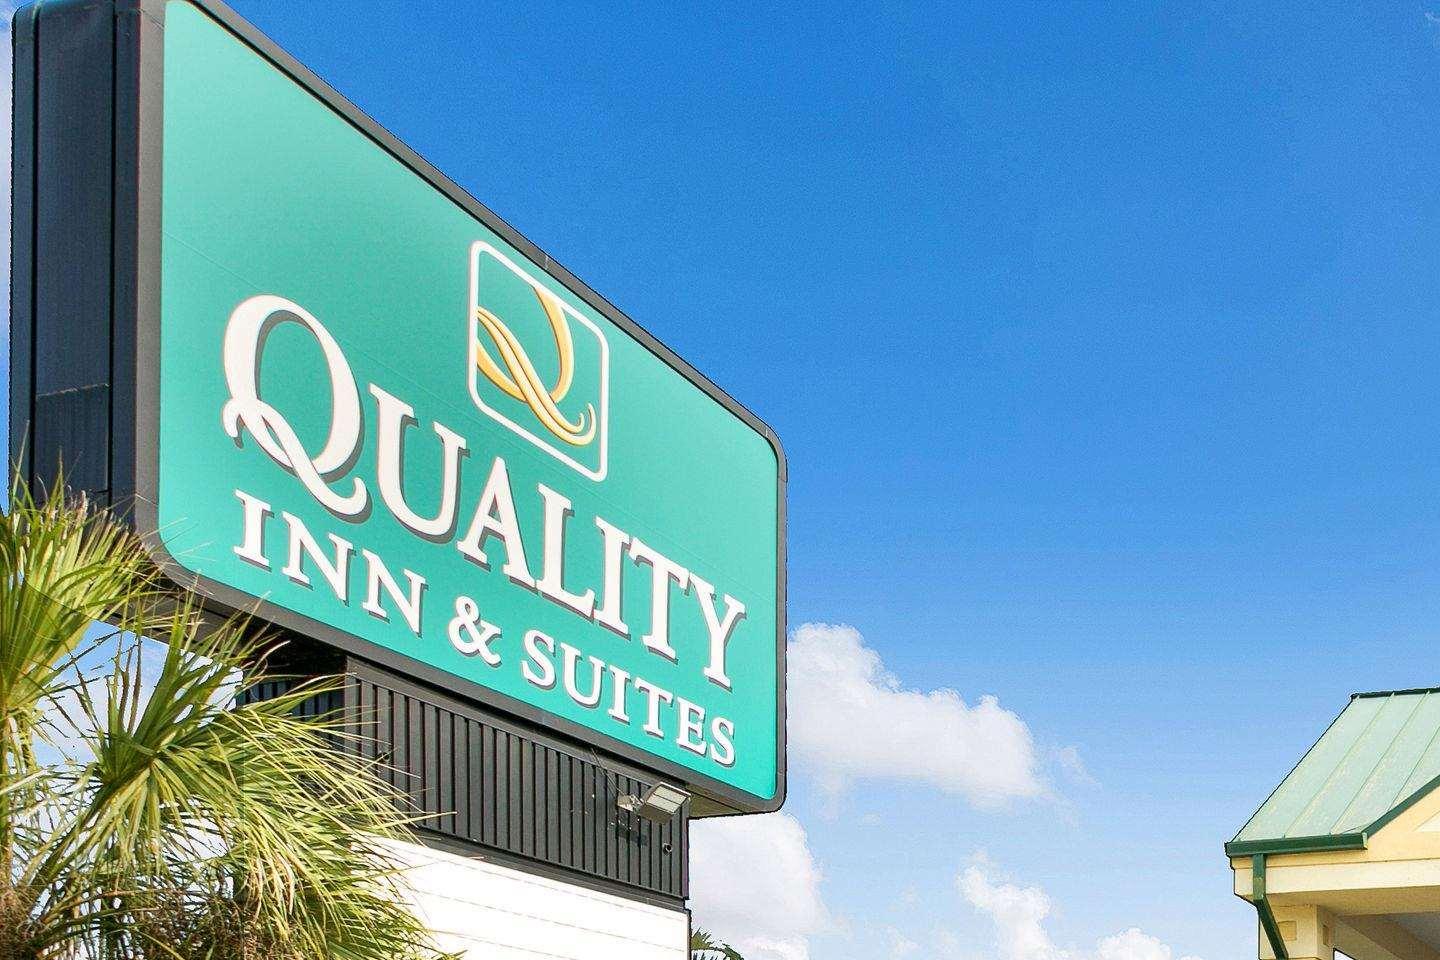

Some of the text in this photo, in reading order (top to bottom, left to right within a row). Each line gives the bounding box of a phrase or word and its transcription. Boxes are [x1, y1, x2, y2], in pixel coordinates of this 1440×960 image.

[221, 294, 748, 691] QUALITY
[232, 489, 737, 767] INN & SUITES
